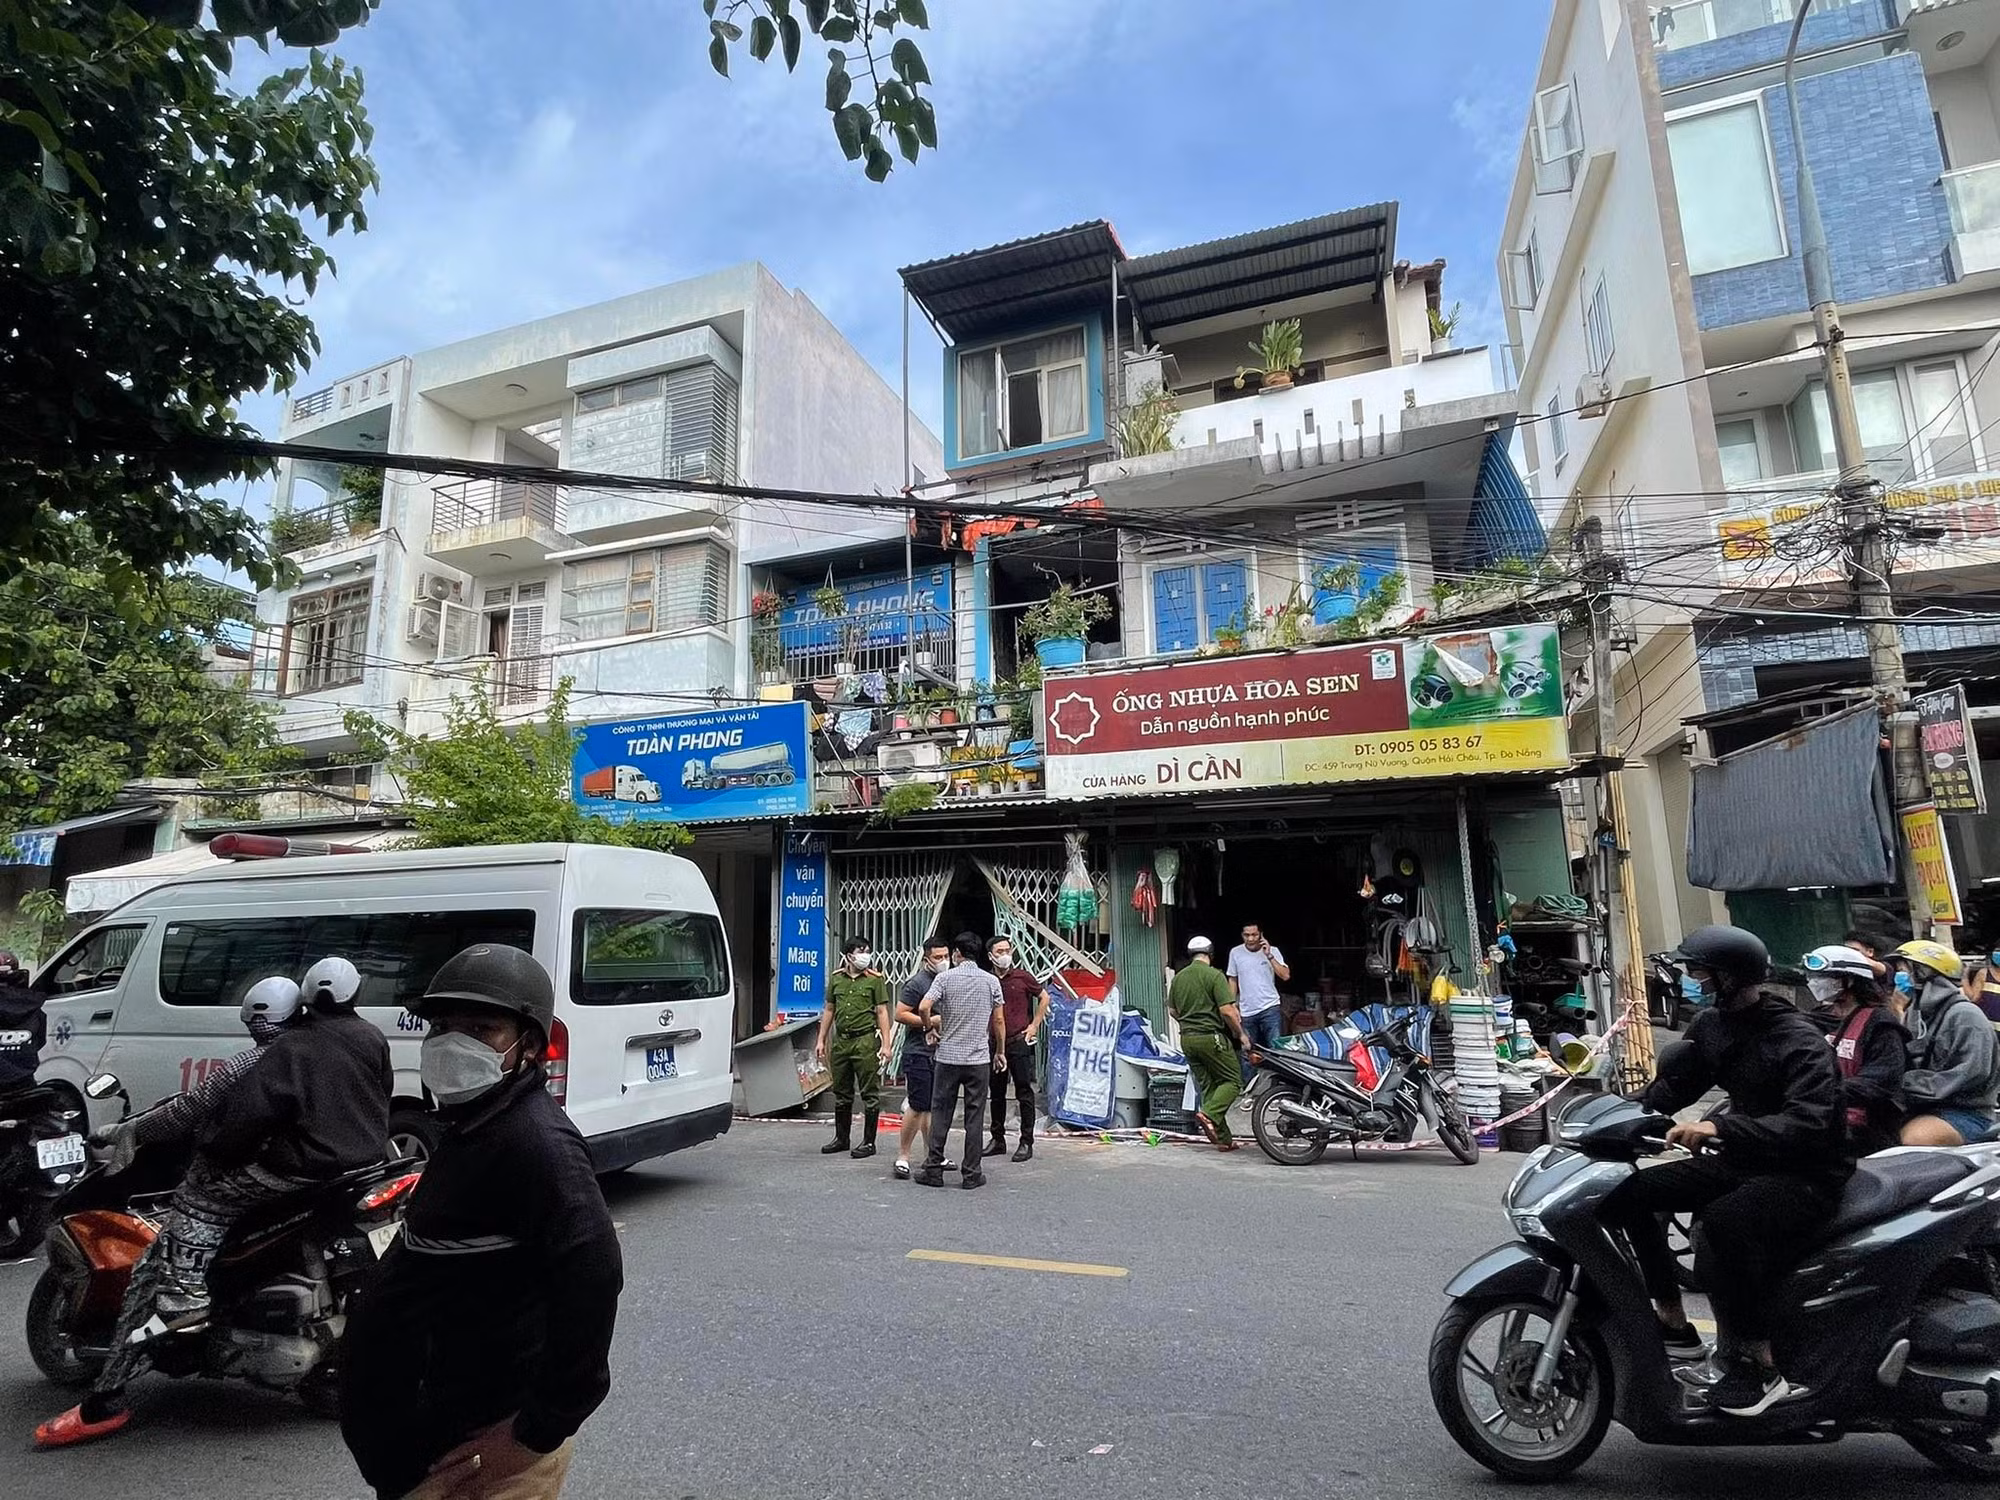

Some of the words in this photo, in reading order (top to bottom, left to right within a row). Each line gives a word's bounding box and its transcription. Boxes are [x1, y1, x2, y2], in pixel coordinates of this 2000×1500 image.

[1111, 687, 1164, 714] ỐNG
[1168, 683, 1239, 709] NHỰA
[1244, 678, 1301, 702] HOA
[1306, 672, 1360, 696] SEN
[612, 725, 636, 735] CÔNG
[637, 723, 646, 732] TY
[646, 722, 666, 731] TNHH
[699, 716, 714, 726] MẠI
[715, 714, 728, 724] VÀ
[728, 712, 746, 723] VẬN
[747, 710, 760, 720] TẢI
[1140, 716, 1174, 736] Dẫn
[1178, 710, 1231, 734] nguồn
[1234, 708, 1280, 731] hạnh
[1284, 704, 1331, 727] phúc
[626, 731, 674, 756] TOÀN
[677, 728, 744, 752] PHONG
[1354, 744, 1375, 756] ĐT:
[1379, 740, 1415, 754] 0905
[1419, 738, 1437, 751] 05
[1442, 736, 1460, 749] 83
[1465, 735, 1482, 748] 67
[1082, 772, 1107, 789] CỬA
[1110, 771, 1147, 787] HÀNG
[1156, 756, 1181, 784] DÌ
[1187, 752, 1242, 781] CẦN
[1304, 762, 1320, 772] ĐC:
[1322, 761, 1338, 771] 459
[796, 865, 815, 884] vận
[786, 888, 824, 912] chuyển
[798, 918, 810, 936] Xi
[788, 946, 818, 968] Măng
[793, 974, 811, 993] Rời
[397, 1011, 424, 1031] 43A
[1077, 1011, 1116, 1038] SIM
[653, 1047, 669, 1063] 43A
